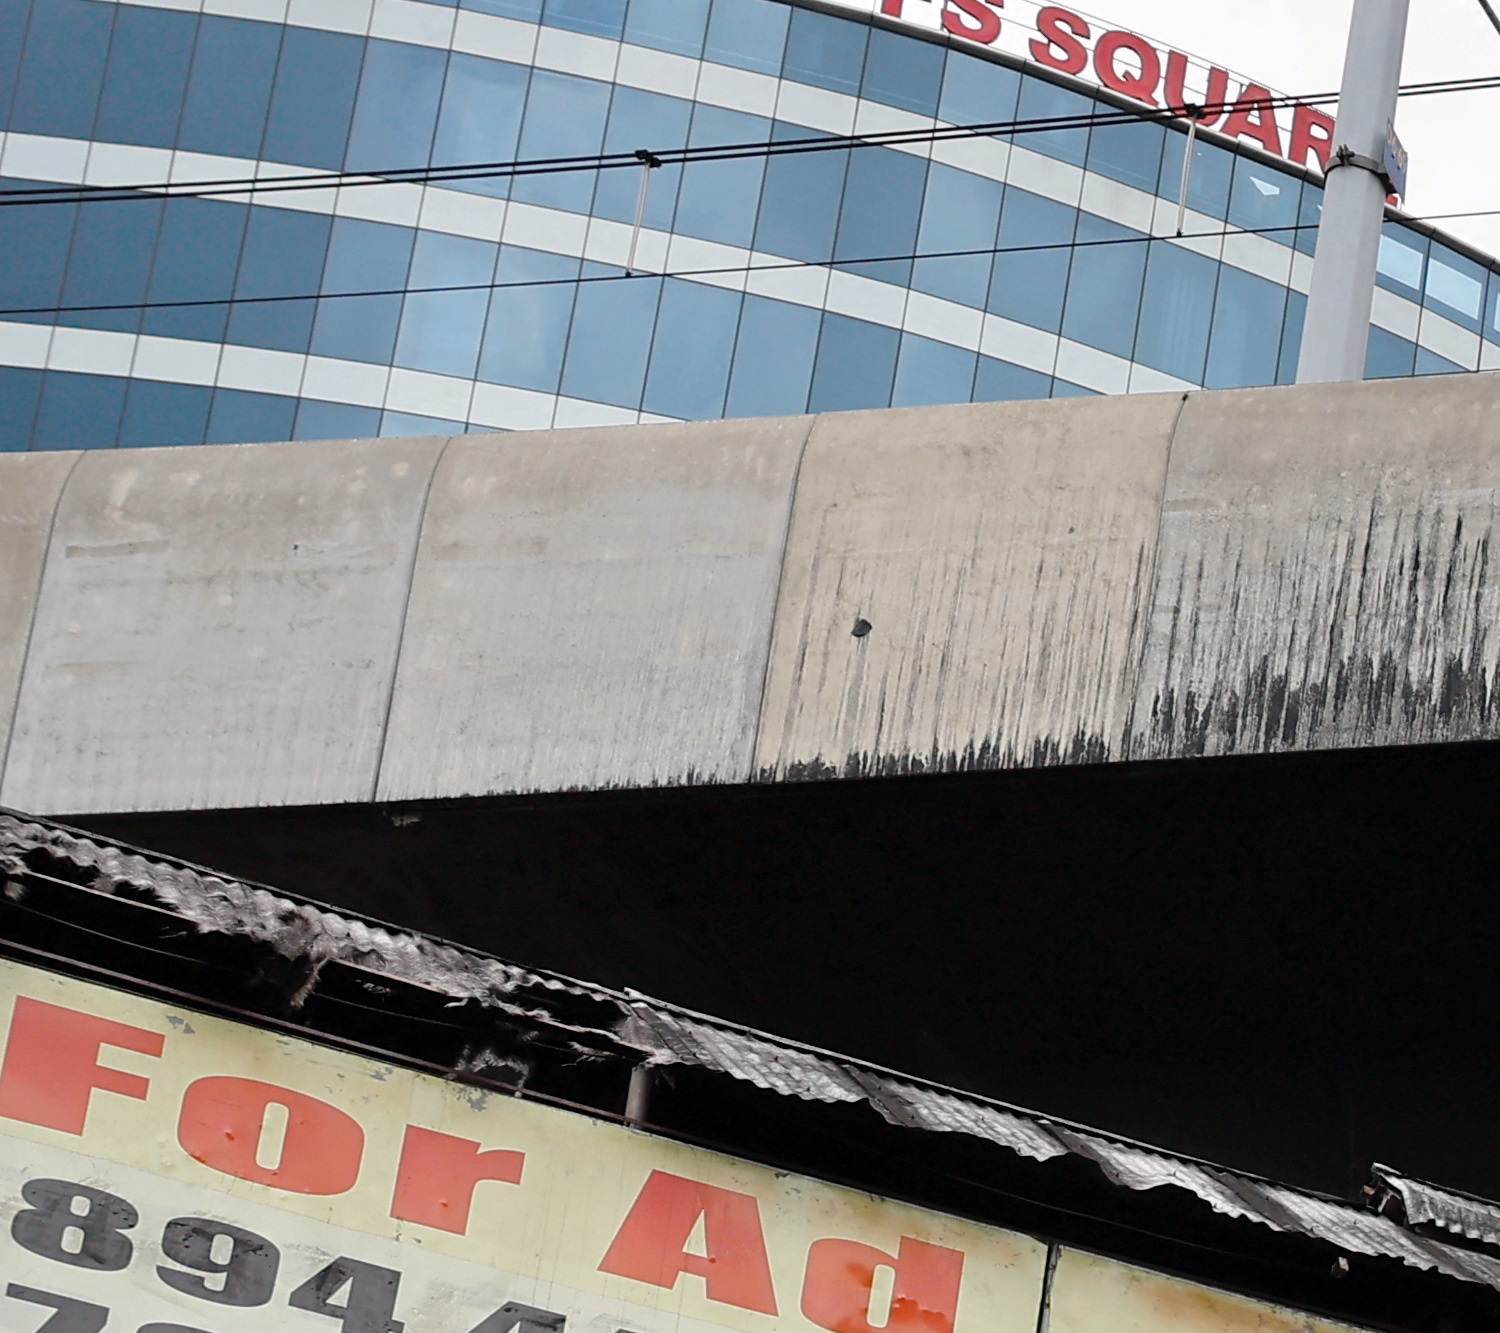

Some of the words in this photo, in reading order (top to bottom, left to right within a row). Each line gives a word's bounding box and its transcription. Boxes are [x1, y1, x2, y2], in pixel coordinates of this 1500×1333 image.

[882, 0, 1003, 45] S
[1029, 5, 1397, 206] SQUAR
[0, 994, 526, 1236] For
